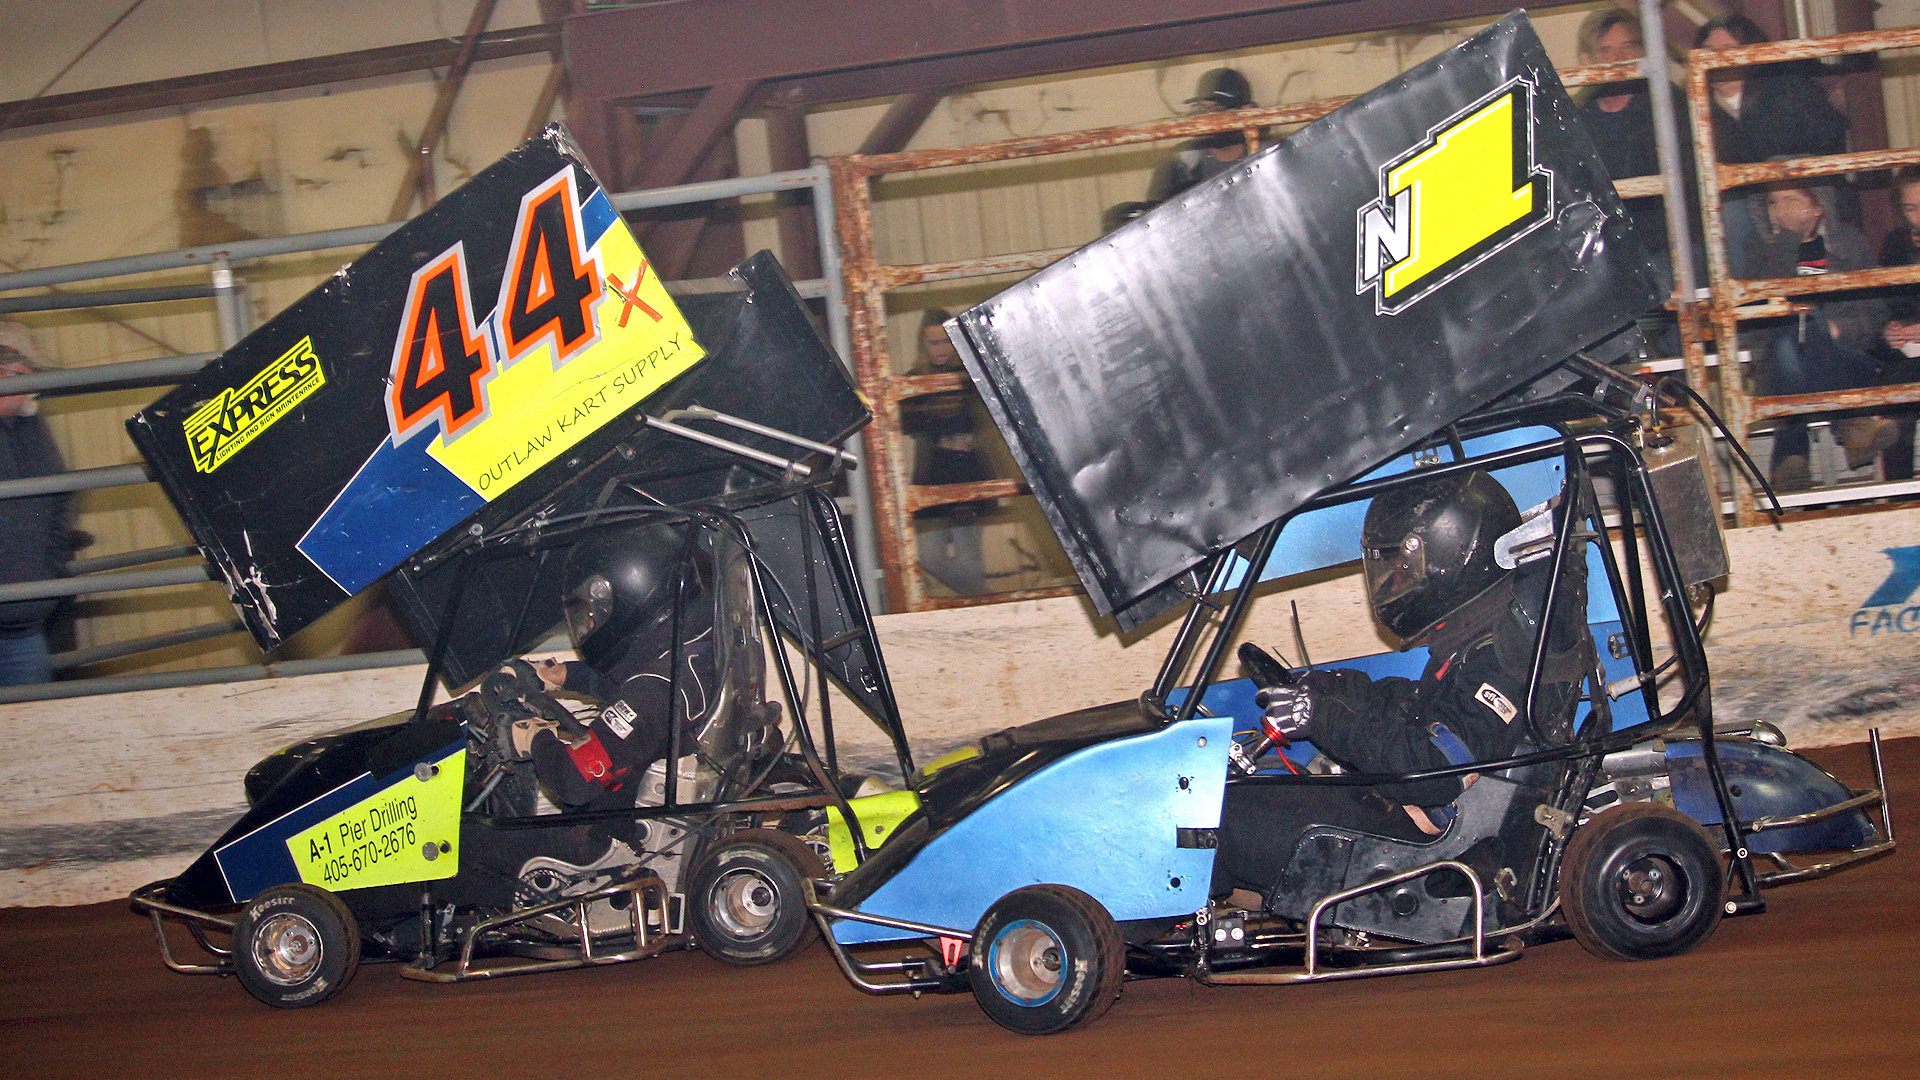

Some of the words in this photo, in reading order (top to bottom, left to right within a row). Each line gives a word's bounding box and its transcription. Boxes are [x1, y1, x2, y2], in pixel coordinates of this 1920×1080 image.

[190, 349, 317, 468] EXPRESS
[215, 436, 245, 461] LIGHTING
[246, 424, 259, 439] AND
[260, 411, 275, 427] SIGN
[276, 376, 320, 413] MAINTENANCE
[478, 426, 552, 491] OUTLAW
[556, 386, 607, 432] KART
[613, 332, 681, 395] SUPPLY
[310, 831, 332, 863] A-1
[339, 818, 367, 848] Pier
[369, 795, 418, 833] Drilling
[323, 822, 416, 884] 405-670-2676
